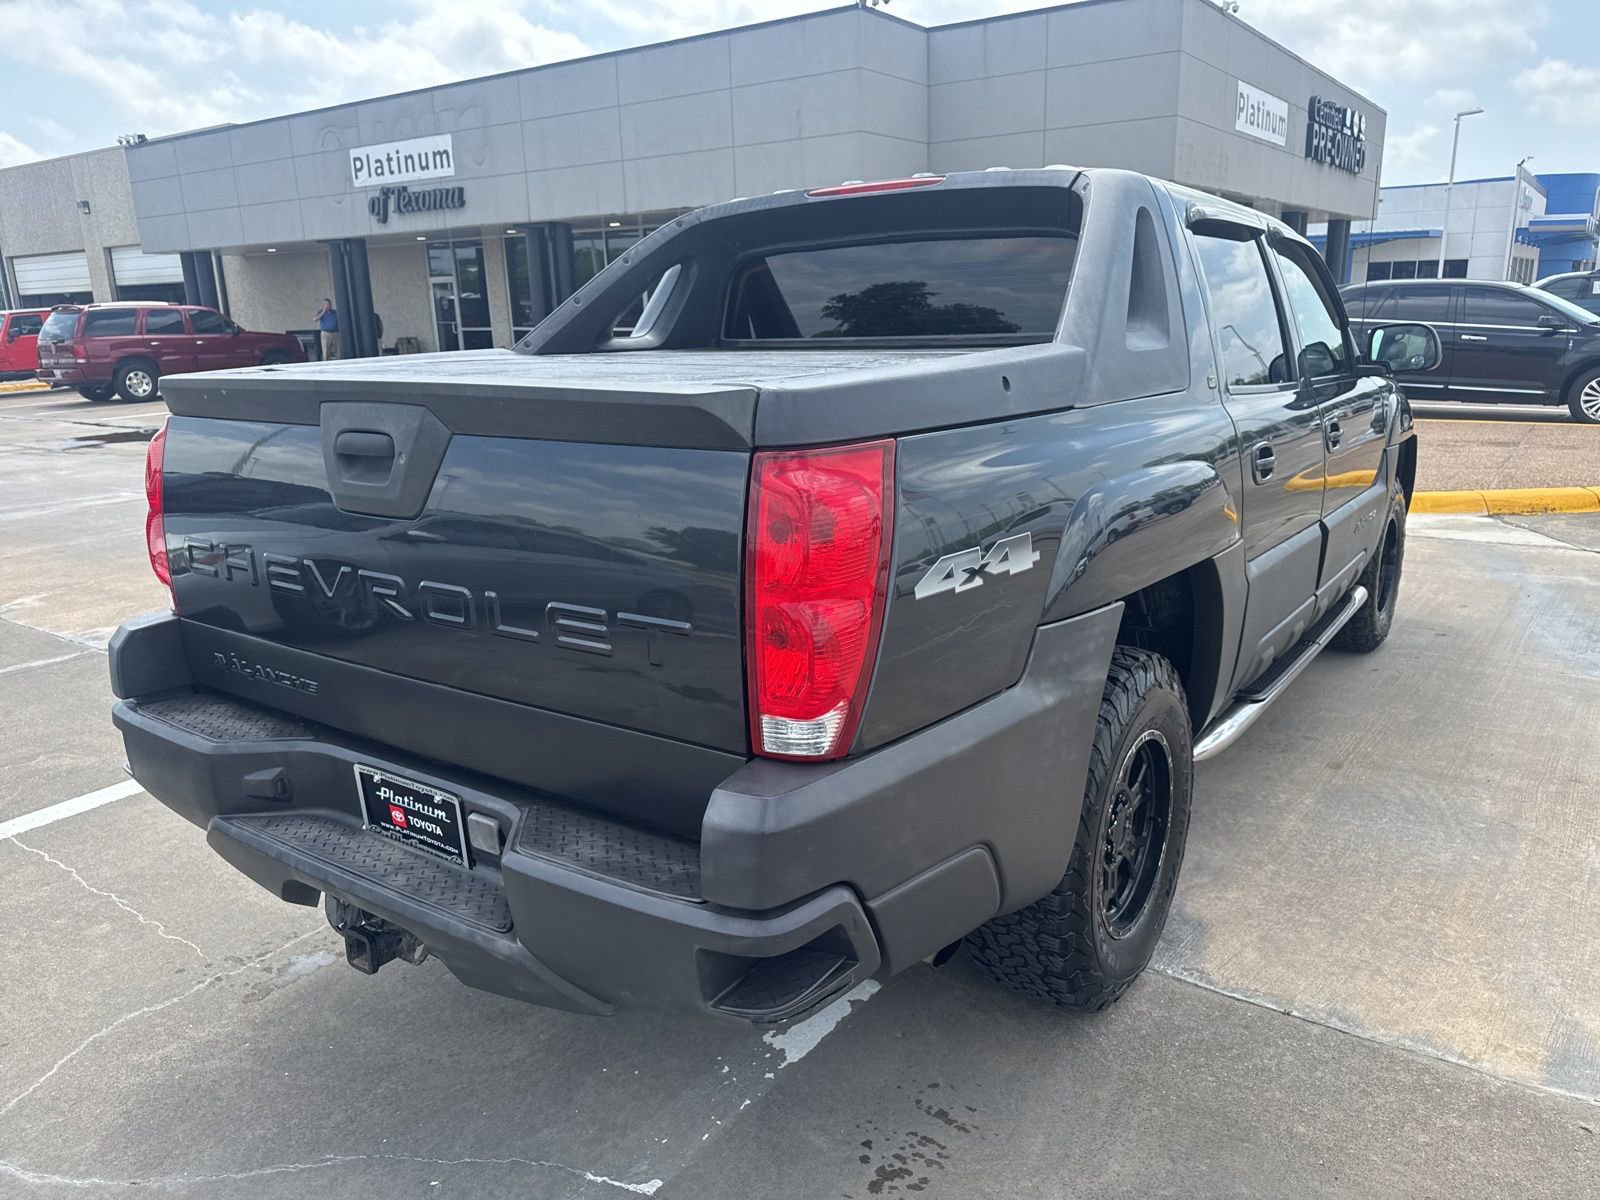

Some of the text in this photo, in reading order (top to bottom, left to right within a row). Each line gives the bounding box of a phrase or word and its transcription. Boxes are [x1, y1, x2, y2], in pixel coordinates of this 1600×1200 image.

[1237, 92, 1287, 138] Platinum
[352, 149, 451, 180] Platinum
[1307, 122, 1366, 174] PRE-OWNED
[368, 186, 465, 224] of Texoma
[184, 535, 692, 667] CHEVROLET
[376, 786, 451, 823] Platinum
[407, 815, 444, 836] TOYOTA
